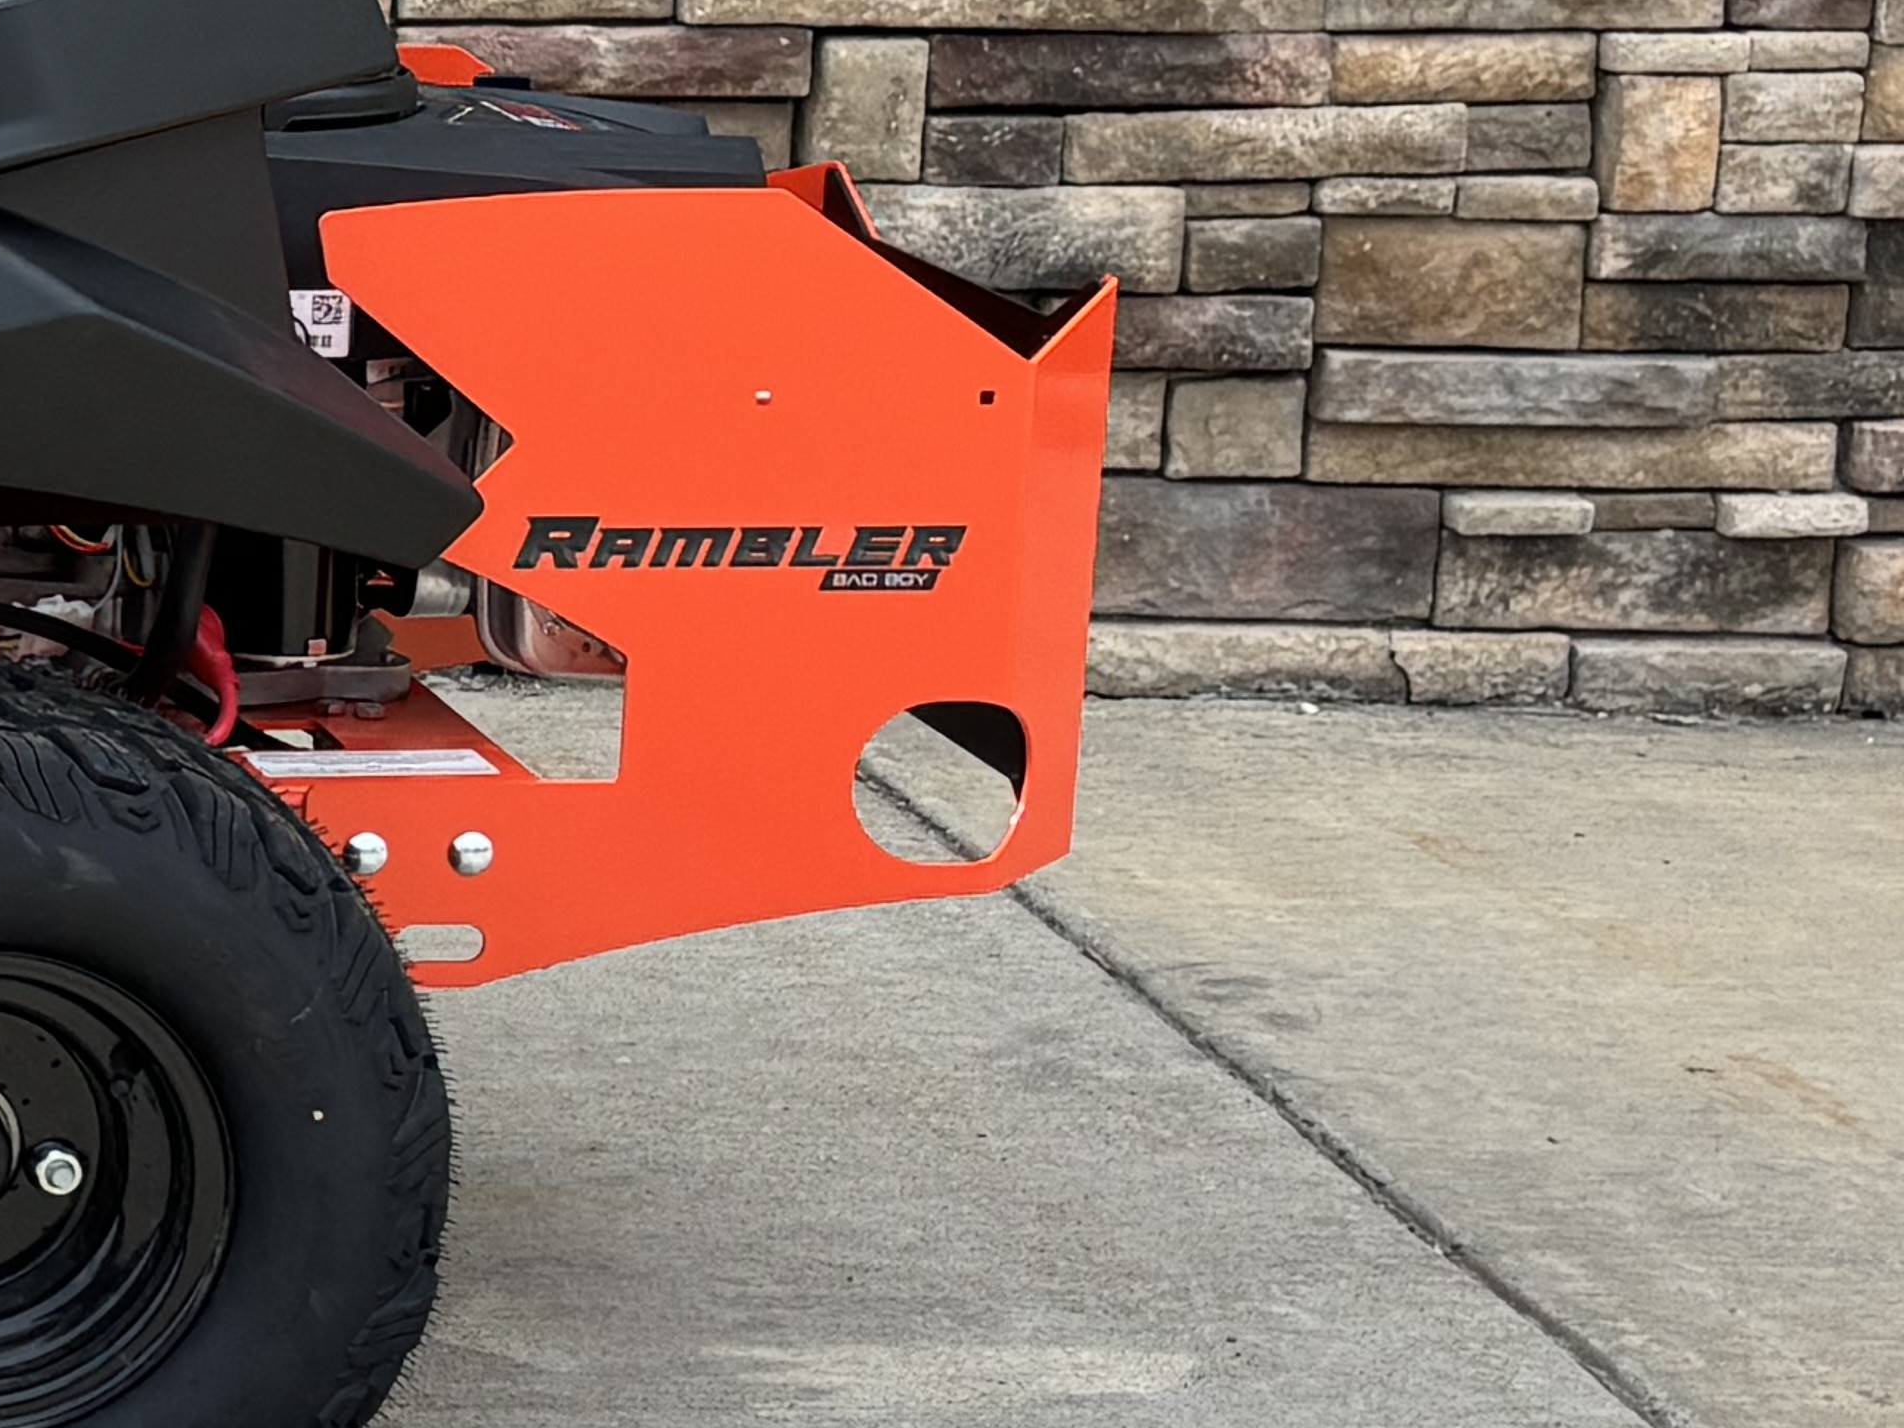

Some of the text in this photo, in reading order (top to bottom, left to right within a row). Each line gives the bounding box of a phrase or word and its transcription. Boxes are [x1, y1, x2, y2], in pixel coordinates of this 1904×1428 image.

[512, 516, 968, 569] RAMBLER
[832, 572, 930, 587] BAD BOY
